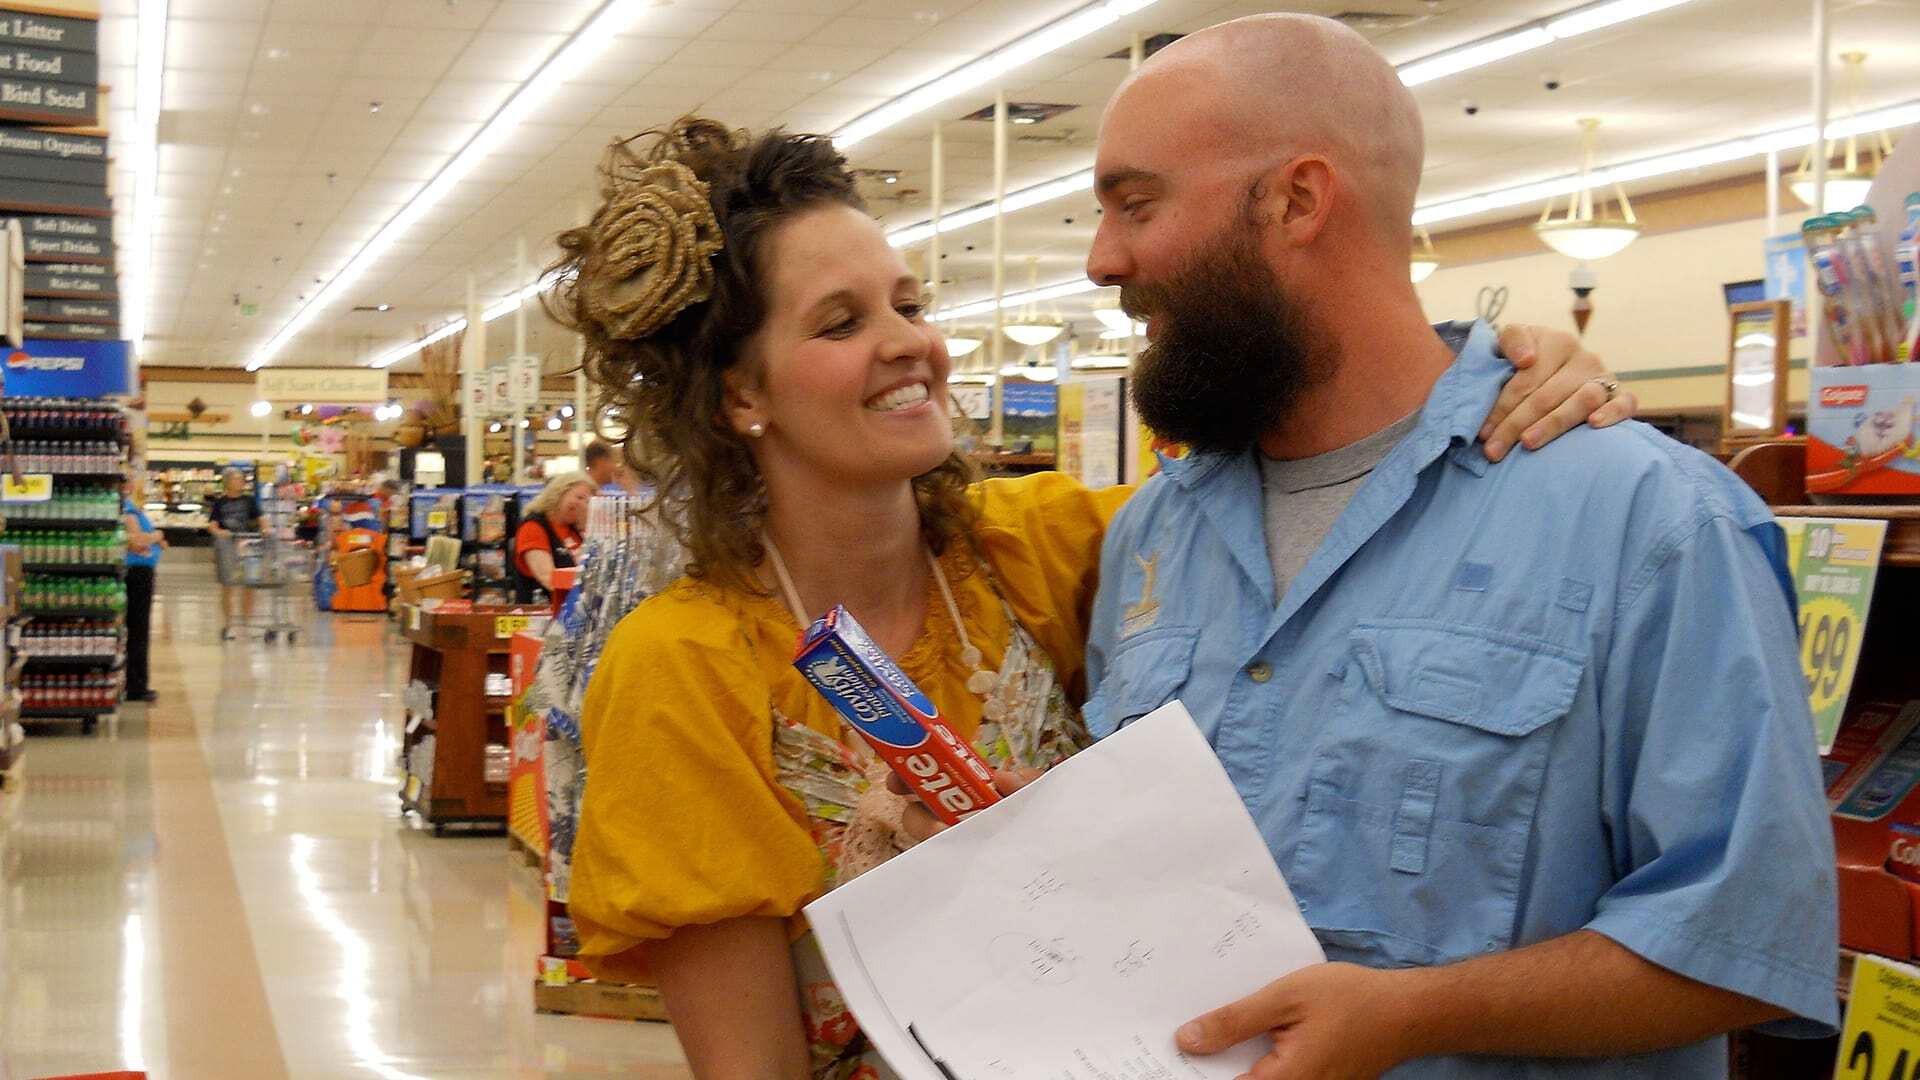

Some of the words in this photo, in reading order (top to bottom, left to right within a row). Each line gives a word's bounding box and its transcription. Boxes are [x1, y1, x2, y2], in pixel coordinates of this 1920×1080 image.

[14, 19, 64, 41] Litter
[16, 53, 61, 74] Food
[2, 83, 41, 104] Bird
[45, 88, 85, 109] Seed
[43, 138, 103, 157] Organics
[59, 220, 97, 234] Drinks
[62, 240, 100, 254] Drinks
[31, 357, 85, 370] PEPSI
[825, 666, 881, 723] Cavity
[841, 666, 892, 720] Protection
[906, 753, 979, 819] ate
